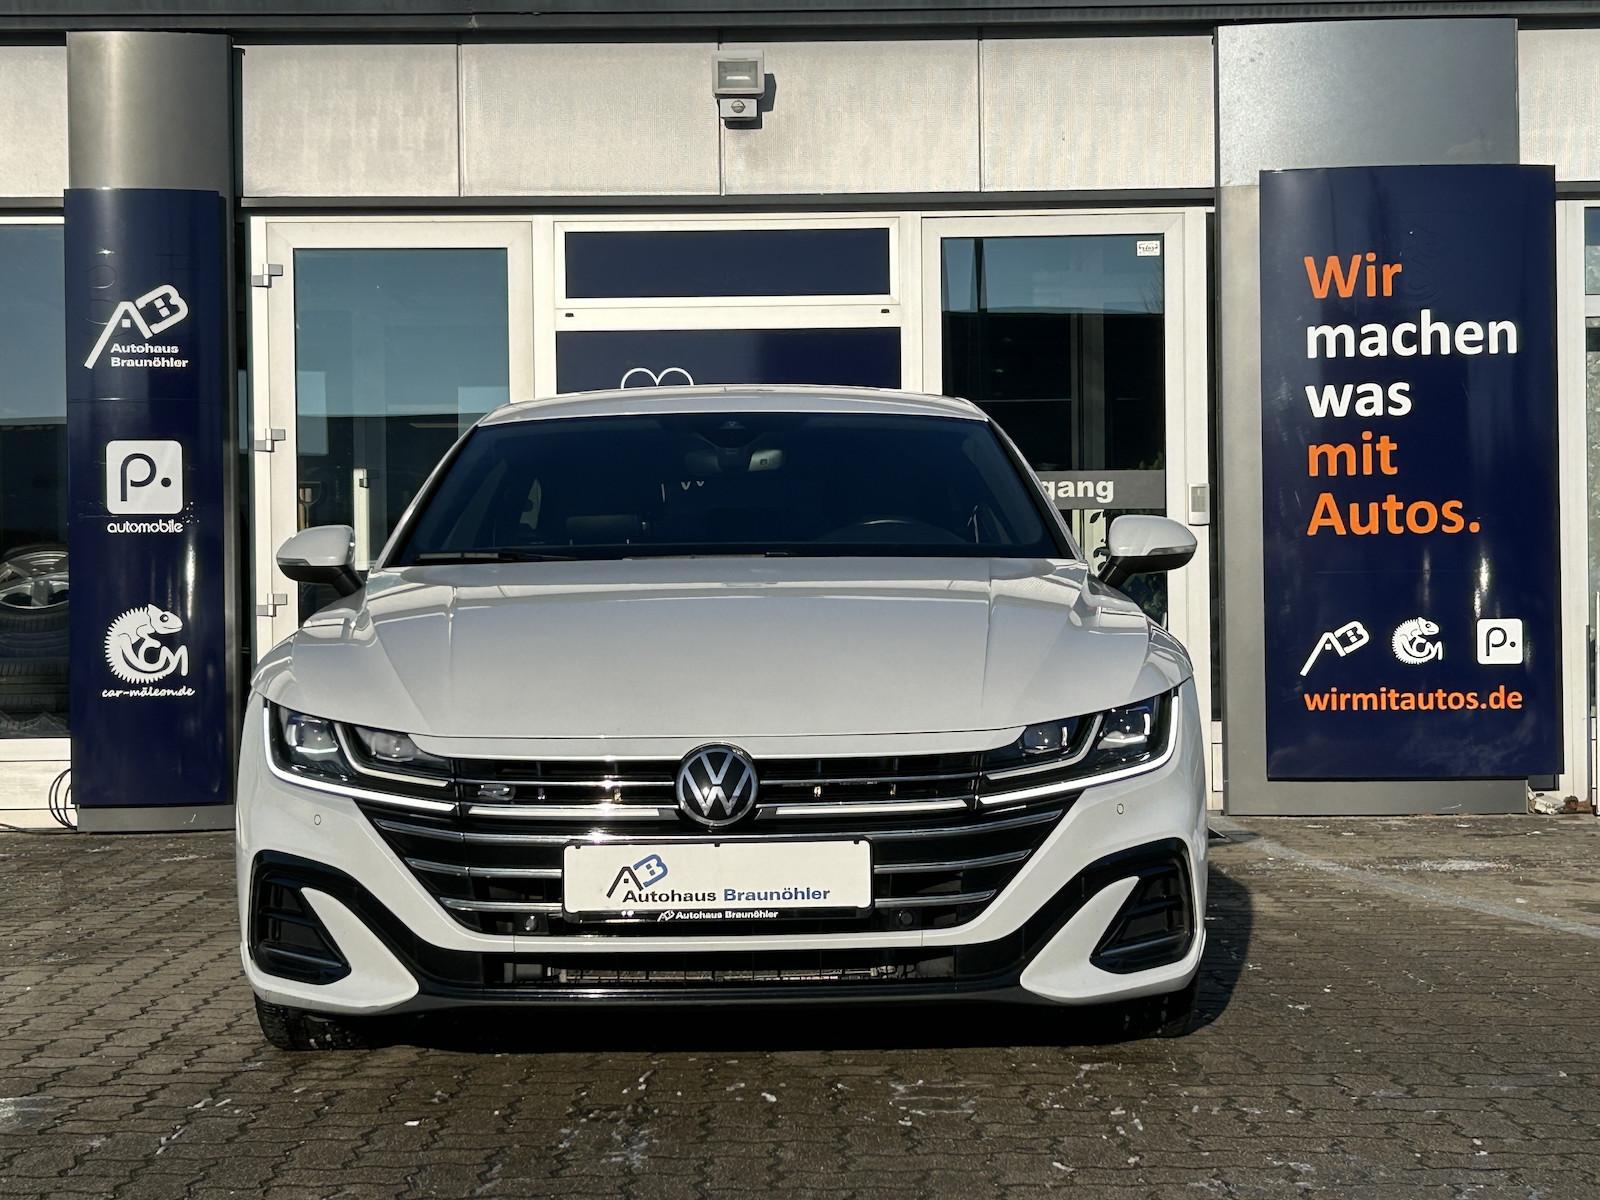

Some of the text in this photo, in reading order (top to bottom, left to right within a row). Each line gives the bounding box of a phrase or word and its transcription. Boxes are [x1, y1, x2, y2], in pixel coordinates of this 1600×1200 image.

[1303, 252, 1403, 299] Wir
[1306, 308, 1518, 359] machen
[110, 343, 179, 354] Autohaus
[110, 356, 189, 368] Braunöhler
[1304, 381, 1413, 418] was
[1308, 430, 1399, 477] mit
[1040, 480, 1114, 504] gang
[107, 518, 184, 534] automobile
[1306, 492, 1482, 536] Autos.
[1303, 685, 1523, 712] wirmitautos.de
[621, 886, 831, 903] Autohaus Braunöhler
[675, 910, 723, 920] Autohaus
[724, 909, 779, 919] Braunöhler
